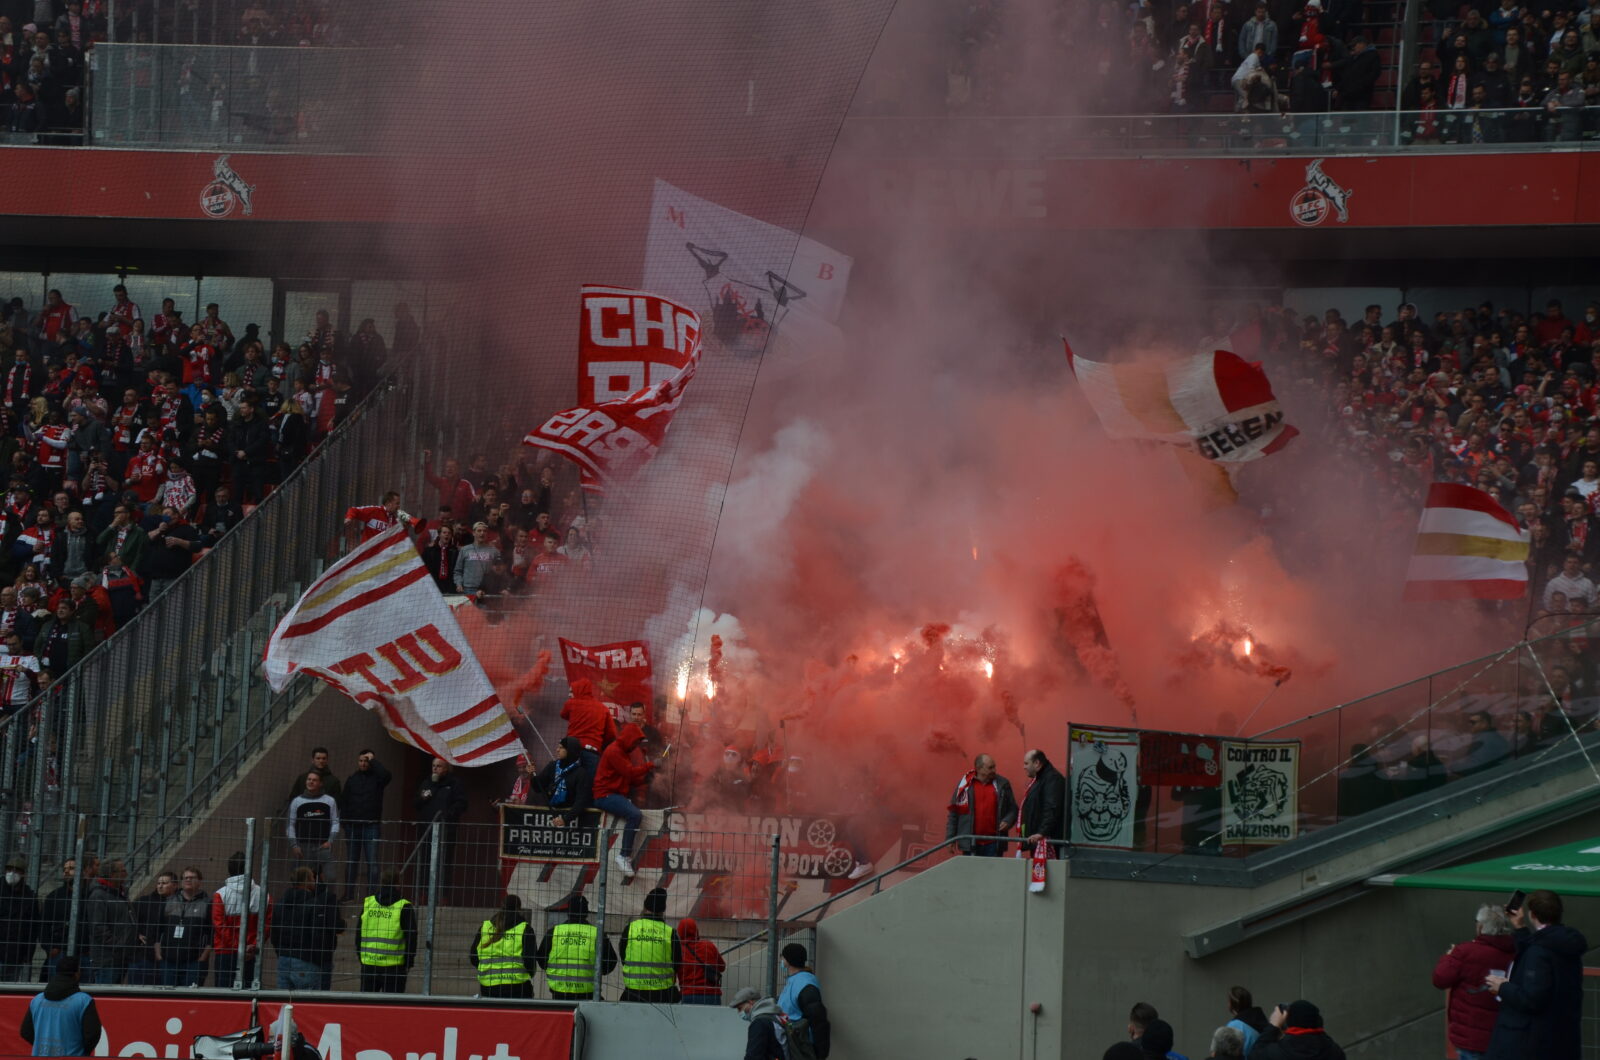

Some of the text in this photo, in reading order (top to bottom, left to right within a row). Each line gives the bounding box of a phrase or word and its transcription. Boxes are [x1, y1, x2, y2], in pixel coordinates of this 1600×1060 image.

[816, 262, 835, 281] B
[565, 645, 648, 670] ULTRA
[1227, 747, 1292, 763] CONTRO IL
[508, 828, 592, 847] PARADISO
[1226, 824, 1290, 839] RAZZISMO
[560, 937, 587, 946] ORDNER
